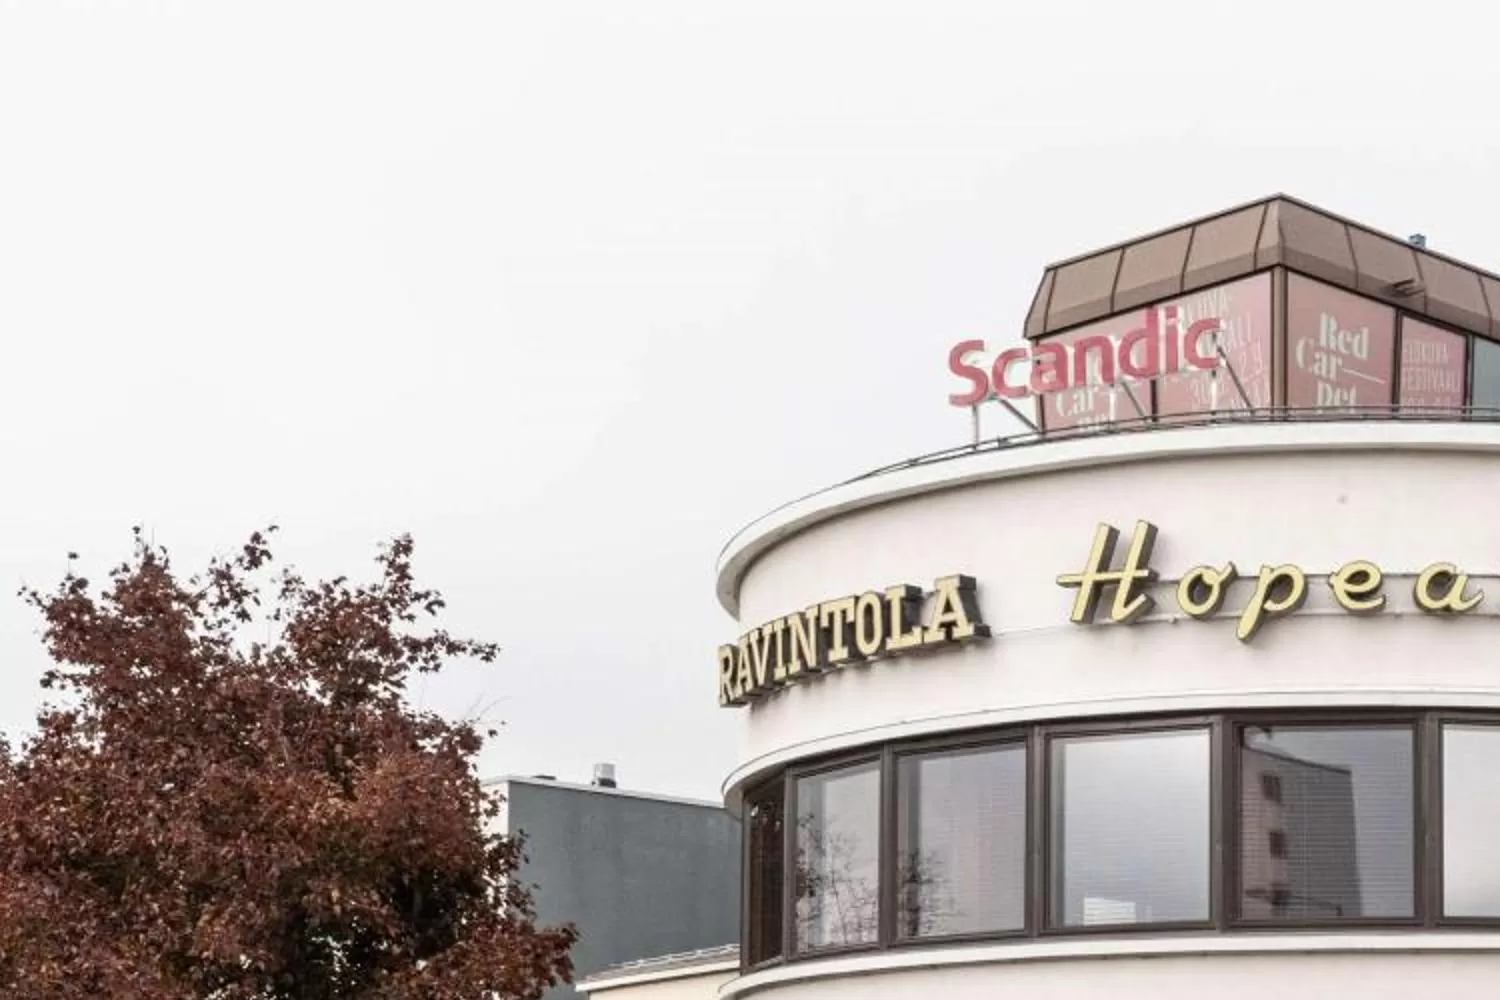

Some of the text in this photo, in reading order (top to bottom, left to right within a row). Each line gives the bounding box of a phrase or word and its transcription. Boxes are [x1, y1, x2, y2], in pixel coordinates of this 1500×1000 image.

[949, 304, 1226, 407] Scandic
[1319, 312, 1369, 360] Red
[718, 574, 990, 707] RAVINTOLA
